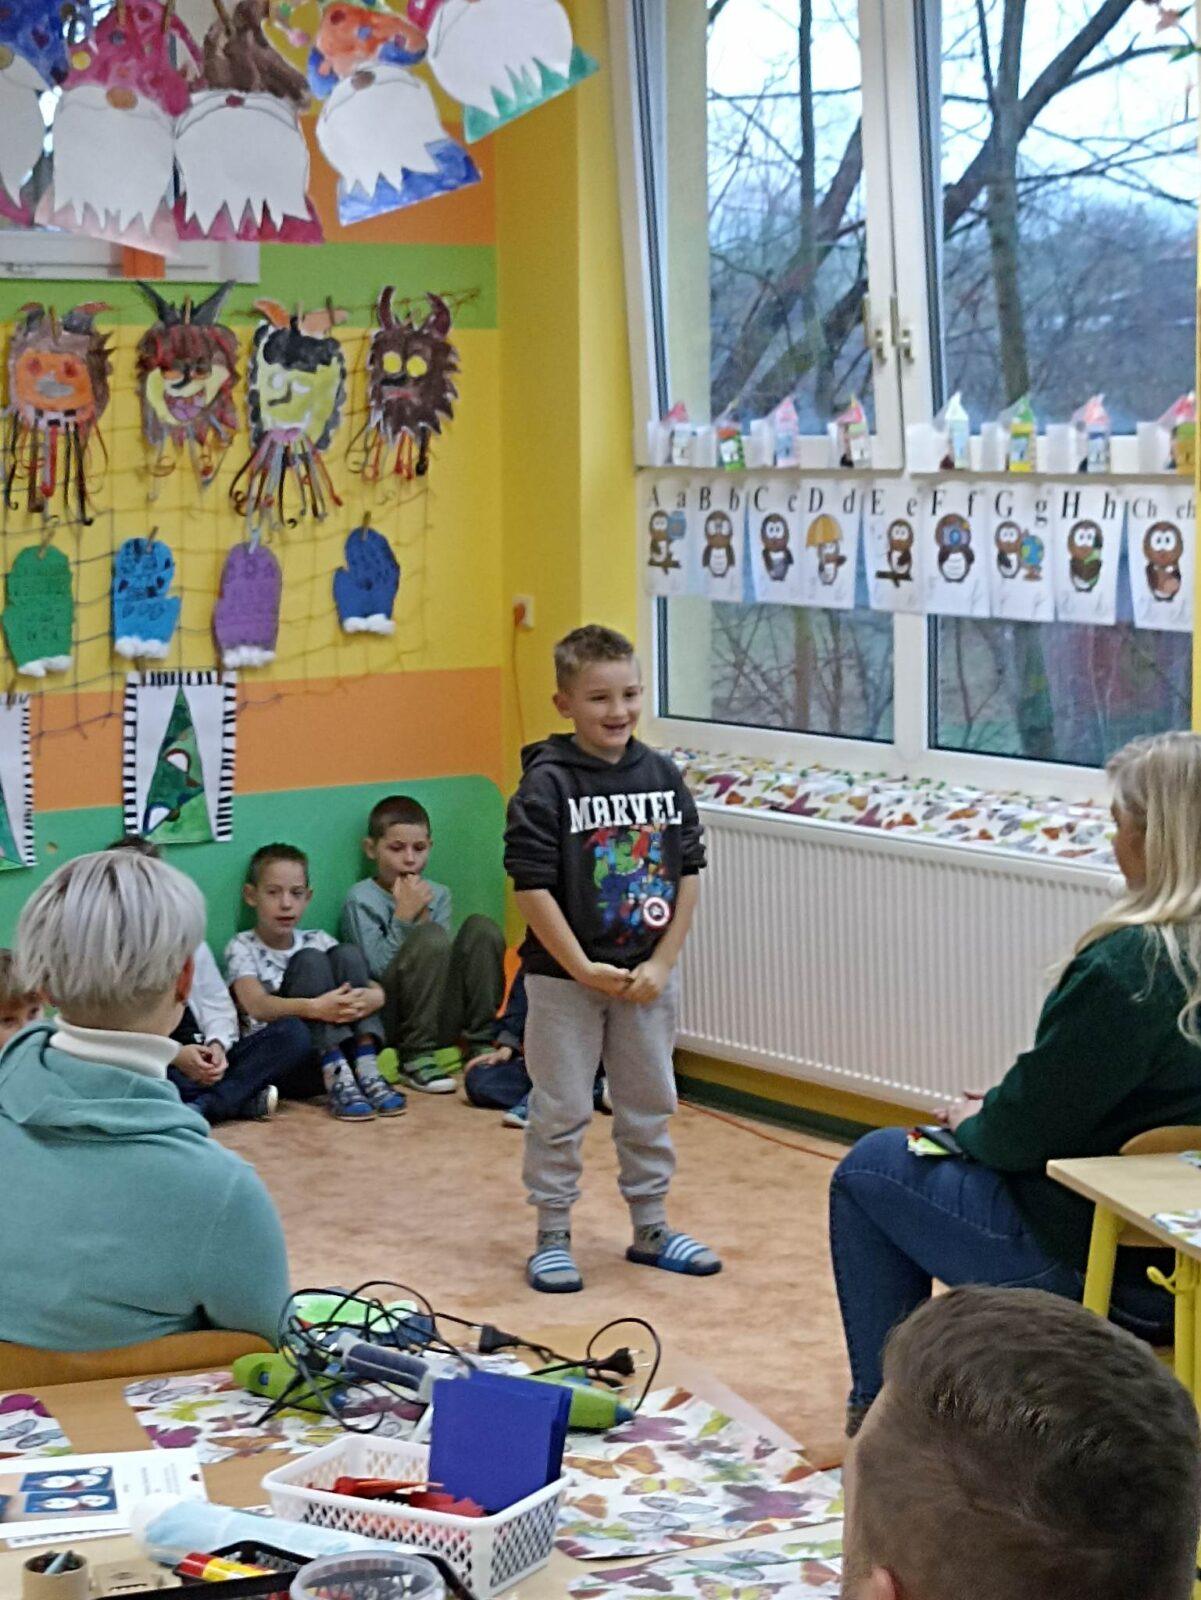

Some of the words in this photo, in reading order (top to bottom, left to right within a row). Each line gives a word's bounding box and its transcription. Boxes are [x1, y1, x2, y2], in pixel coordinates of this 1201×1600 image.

[647, 485, 660, 507] A
[677, 491, 686, 507] a
[699, 486, 711, 511] B
[729, 487, 740, 511] b
[754, 486, 769, 511] C
[808, 487, 824, 513] D
[842, 489, 855, 514] d
[871, 489, 886, 516] E
[907, 498, 918, 516] e
[931, 490, 947, 516] F
[967, 490, 978, 516] f
[995, 490, 1013, 517] G
[1035, 499, 1049, 526] g
[1061, 491, 1081, 519] H
[1102, 493, 1116, 519] h
[1132, 498, 1157, 518] Ch
[568, 790, 682, 833] MARVEL
